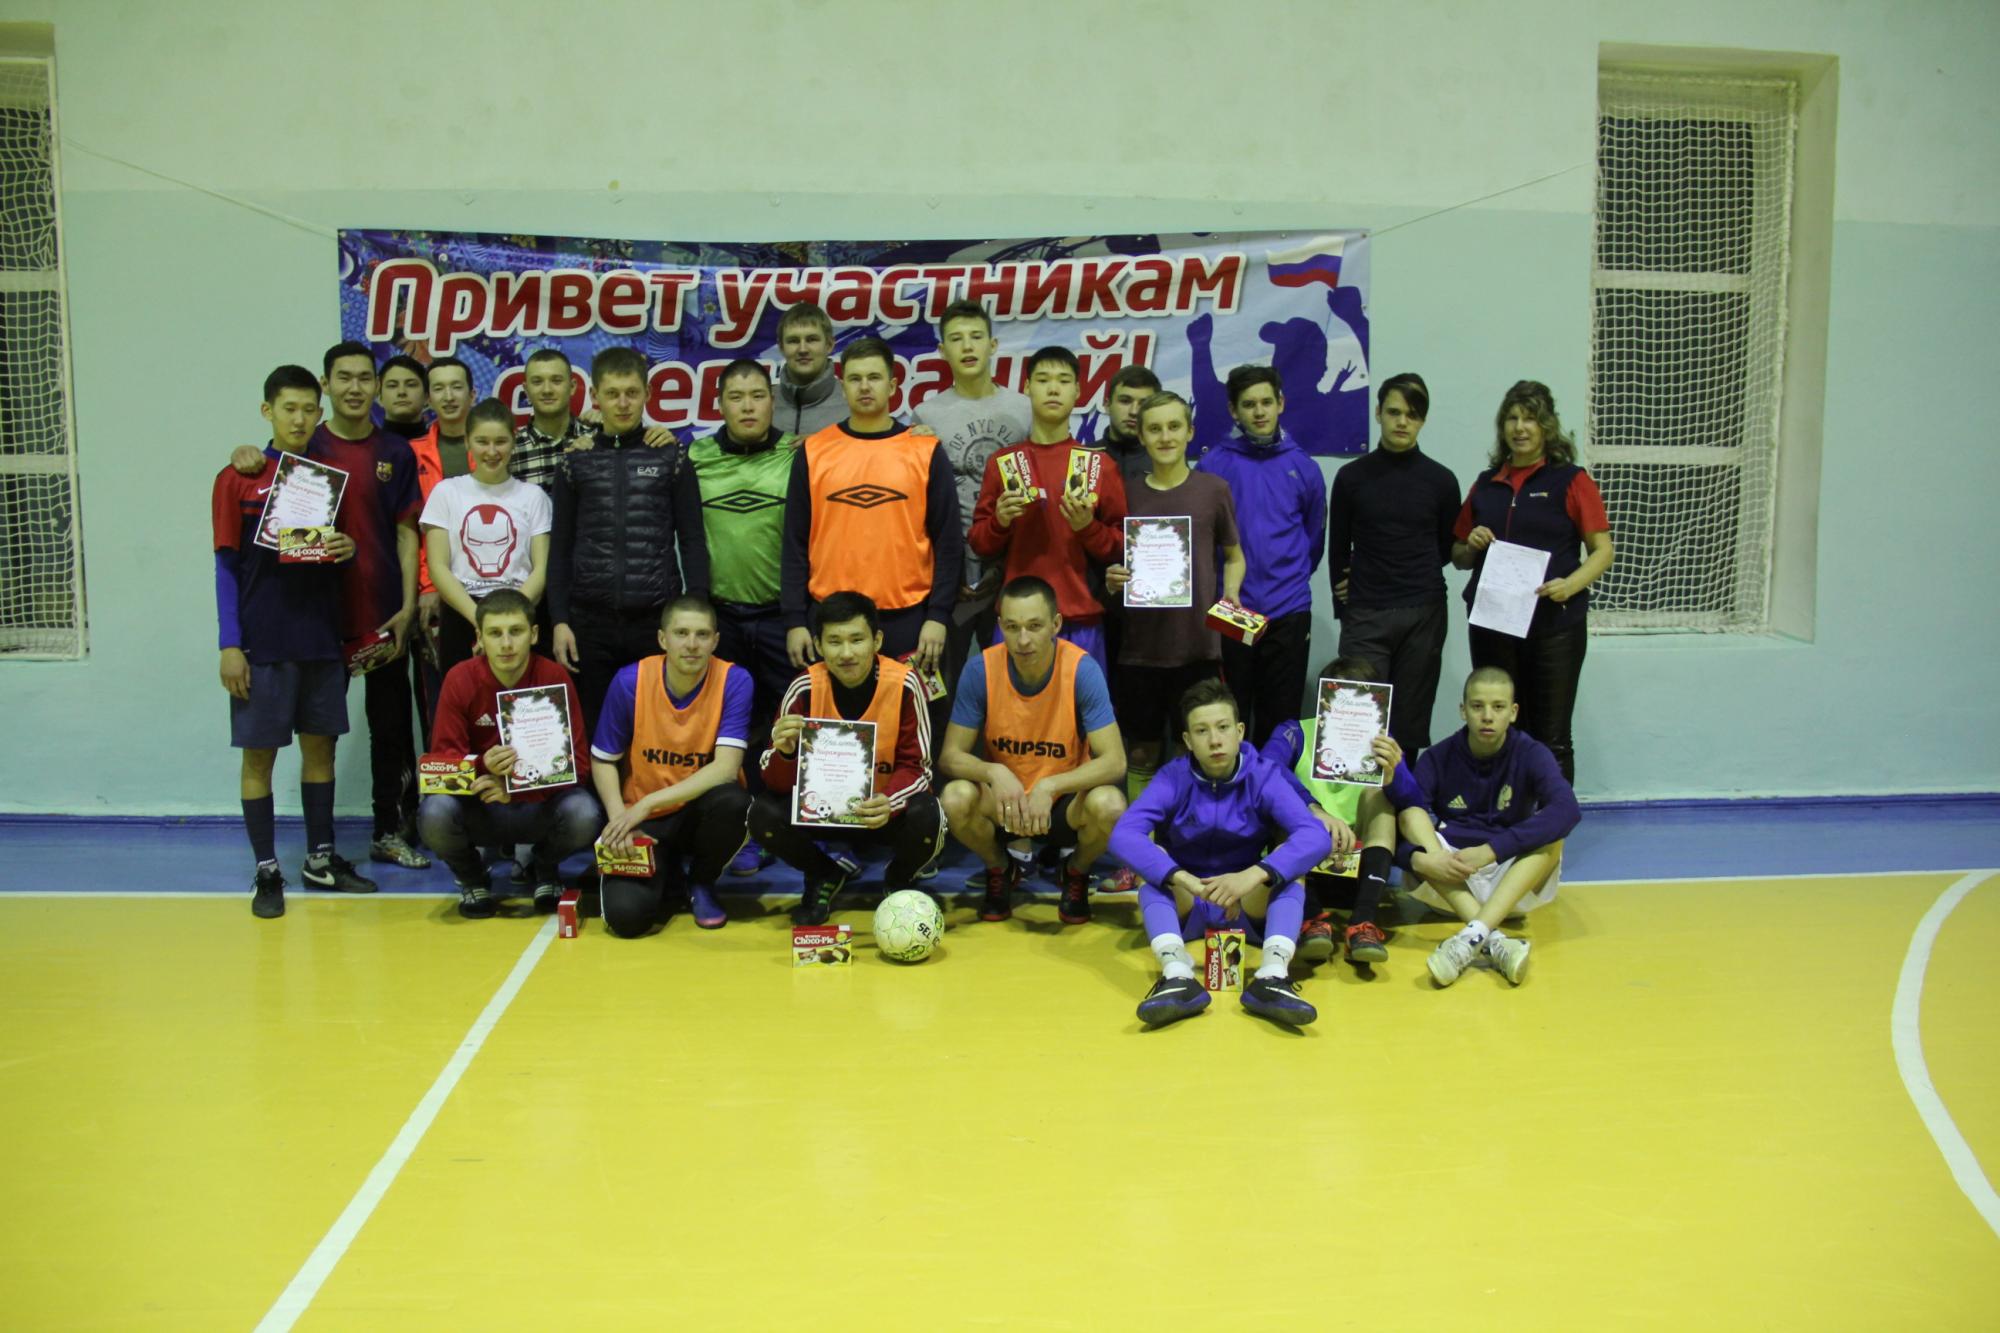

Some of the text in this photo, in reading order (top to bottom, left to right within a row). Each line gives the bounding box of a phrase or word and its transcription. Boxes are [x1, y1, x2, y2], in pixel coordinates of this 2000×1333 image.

[369, 257, 1241, 352] Привет участникам
[637, 466, 659, 476] EA7
[420, 762, 458, 772] Choco-Pie
[794, 936, 835, 946] Choco-Pie
